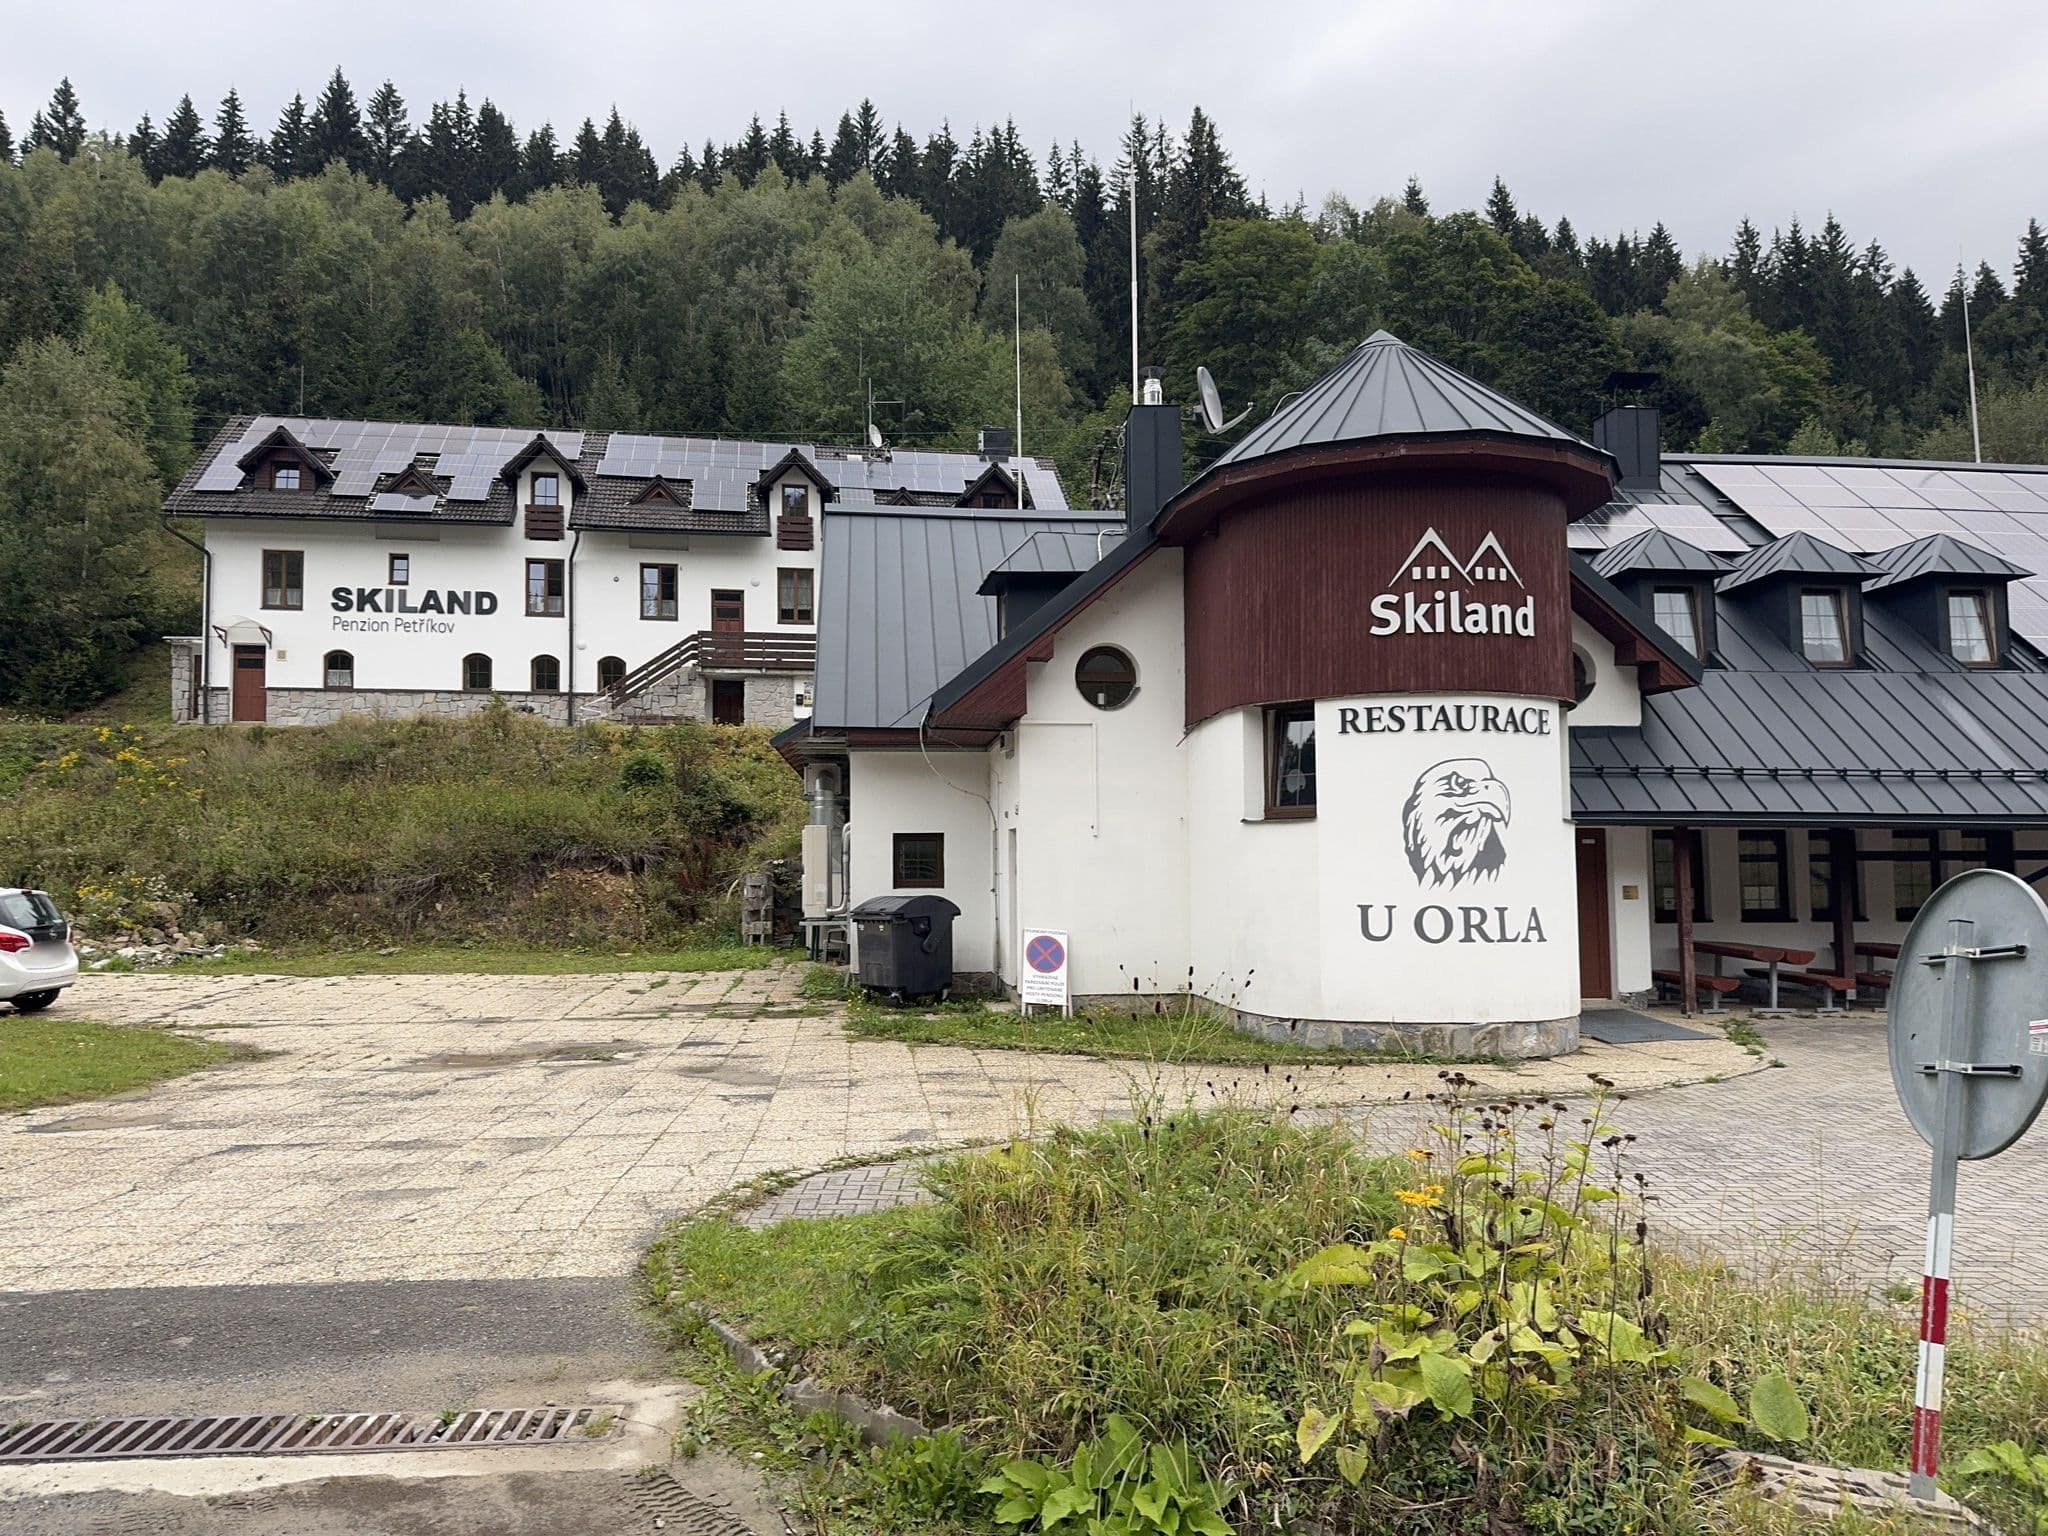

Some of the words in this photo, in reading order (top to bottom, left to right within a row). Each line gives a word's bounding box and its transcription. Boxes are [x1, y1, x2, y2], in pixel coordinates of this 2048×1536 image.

[331, 587, 498, 615] SKILAND
[1369, 590, 1536, 637] Skiland
[333, 616, 389, 632] Penzion
[394, 617, 455, 633] Petříkov
[1338, 704, 1551, 735] RESTAURACE
[1357, 904, 1397, 942] U
[1413, 904, 1547, 944] ORLA
